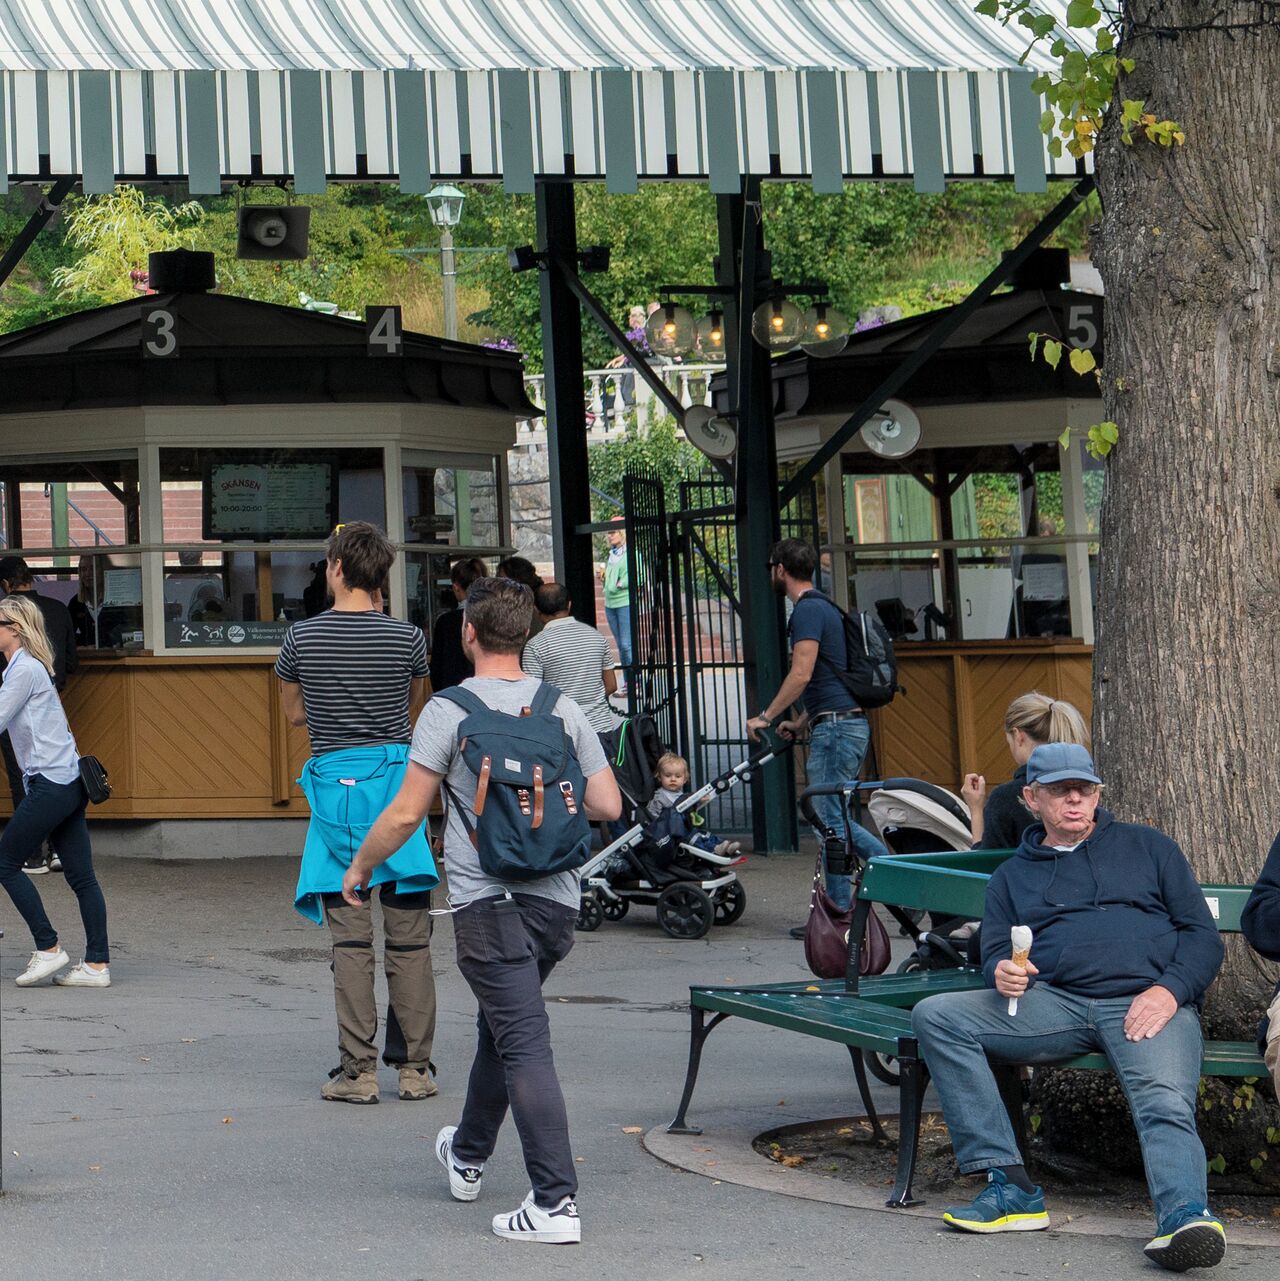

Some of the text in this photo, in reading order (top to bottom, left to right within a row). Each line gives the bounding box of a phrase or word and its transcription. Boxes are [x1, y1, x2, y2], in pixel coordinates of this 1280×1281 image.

[146, 310, 176, 356] 3
[369, 308, 401, 353] 4
[1069, 305, 1097, 349] 5
[221, 480, 261, 491] SKANSEN
